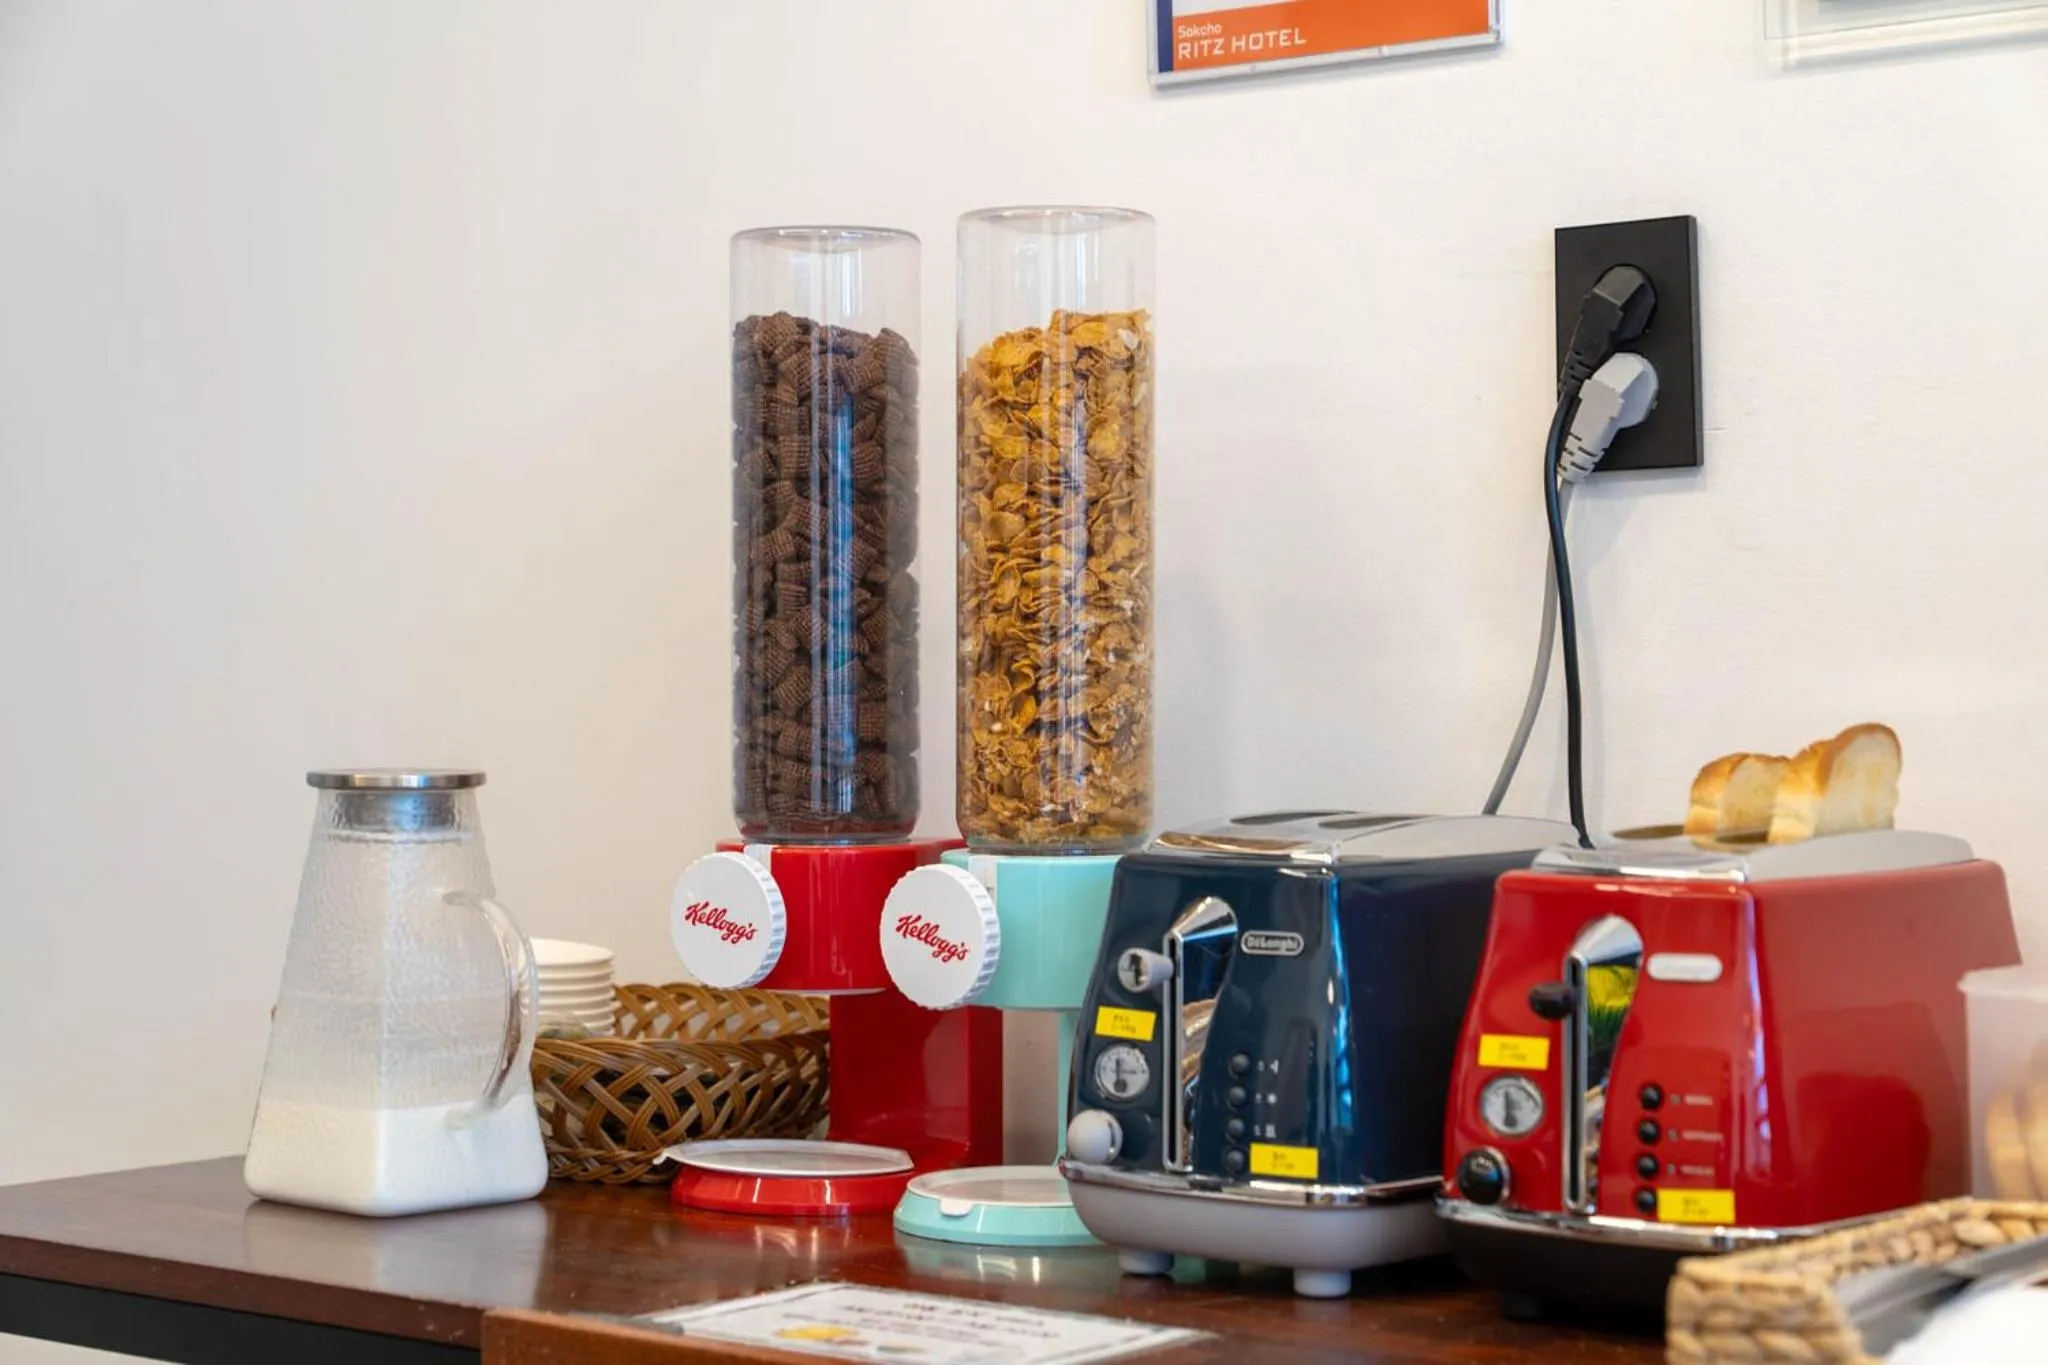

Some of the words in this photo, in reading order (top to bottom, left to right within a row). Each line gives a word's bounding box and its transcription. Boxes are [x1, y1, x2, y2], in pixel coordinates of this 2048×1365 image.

[1178, 38, 1225, 59] RITZ
[1231, 27, 1307, 54] HOTEL
[684, 902, 758, 944] Kellogg's
[895, 914, 970, 963] Kellogg's
